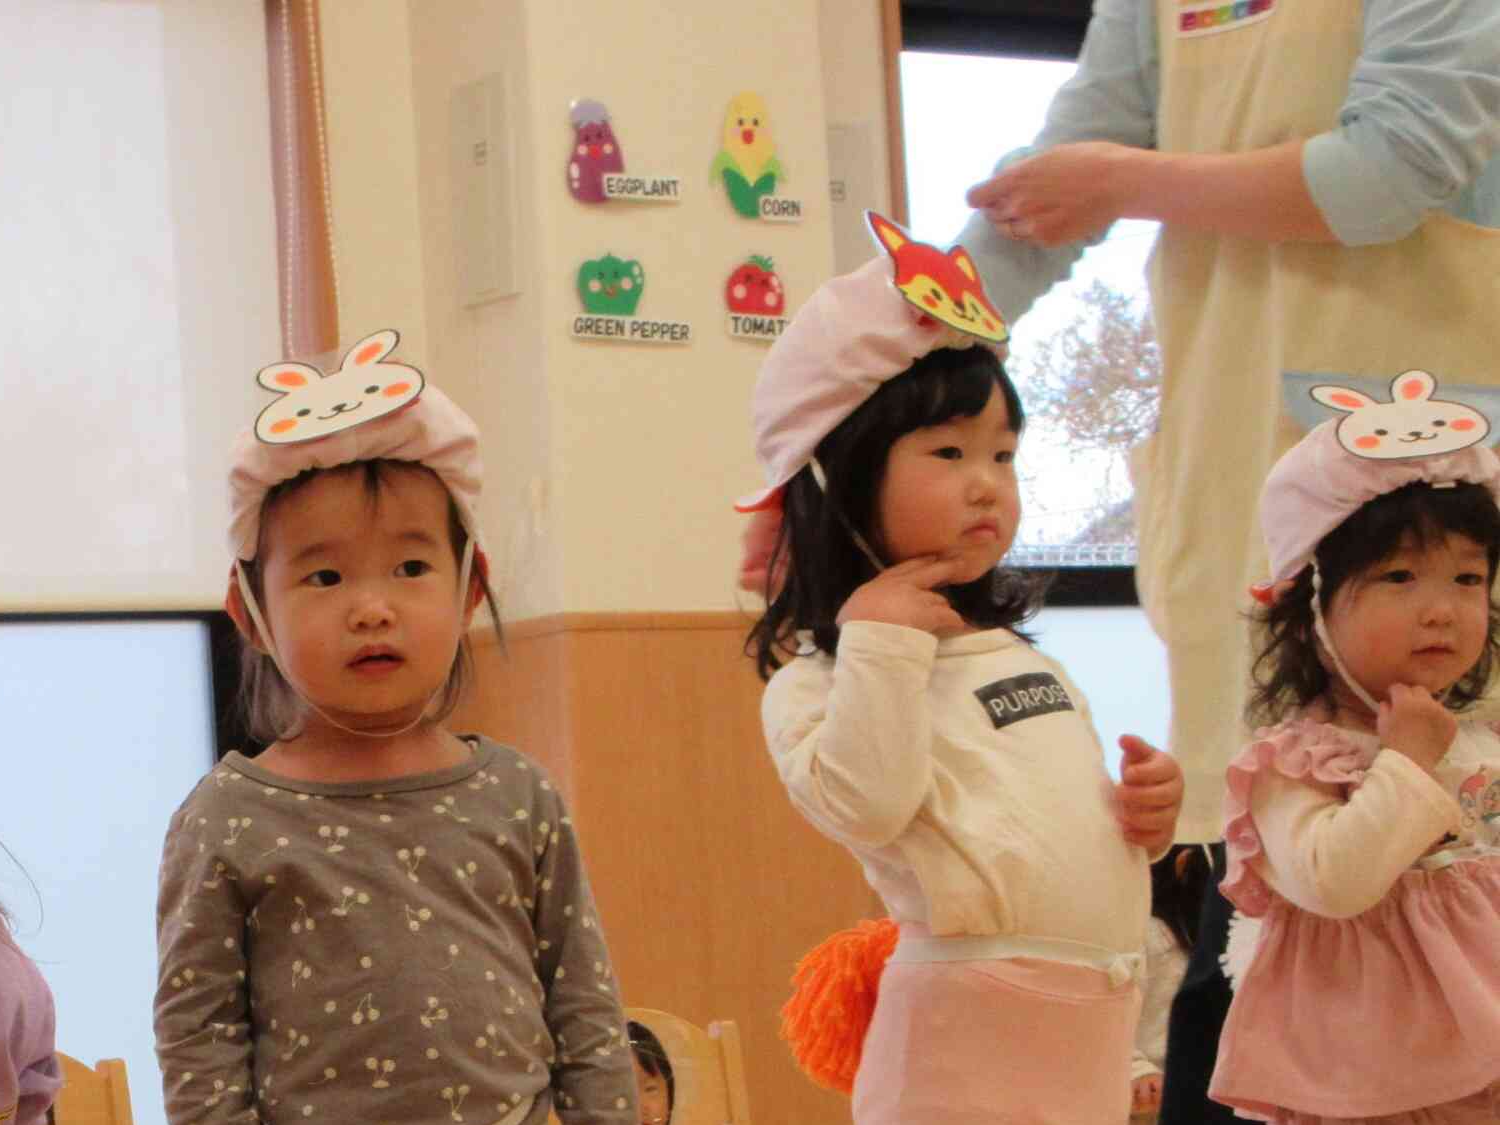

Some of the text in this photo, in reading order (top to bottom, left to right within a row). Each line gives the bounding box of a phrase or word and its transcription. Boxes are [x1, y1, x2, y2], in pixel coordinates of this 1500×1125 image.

[606, 177, 679, 196] EGGPLANT
[762, 198, 800, 216] CORN
[573, 317, 690, 341] GREEN PEPPER
[731, 316, 790, 335] TOMAT
